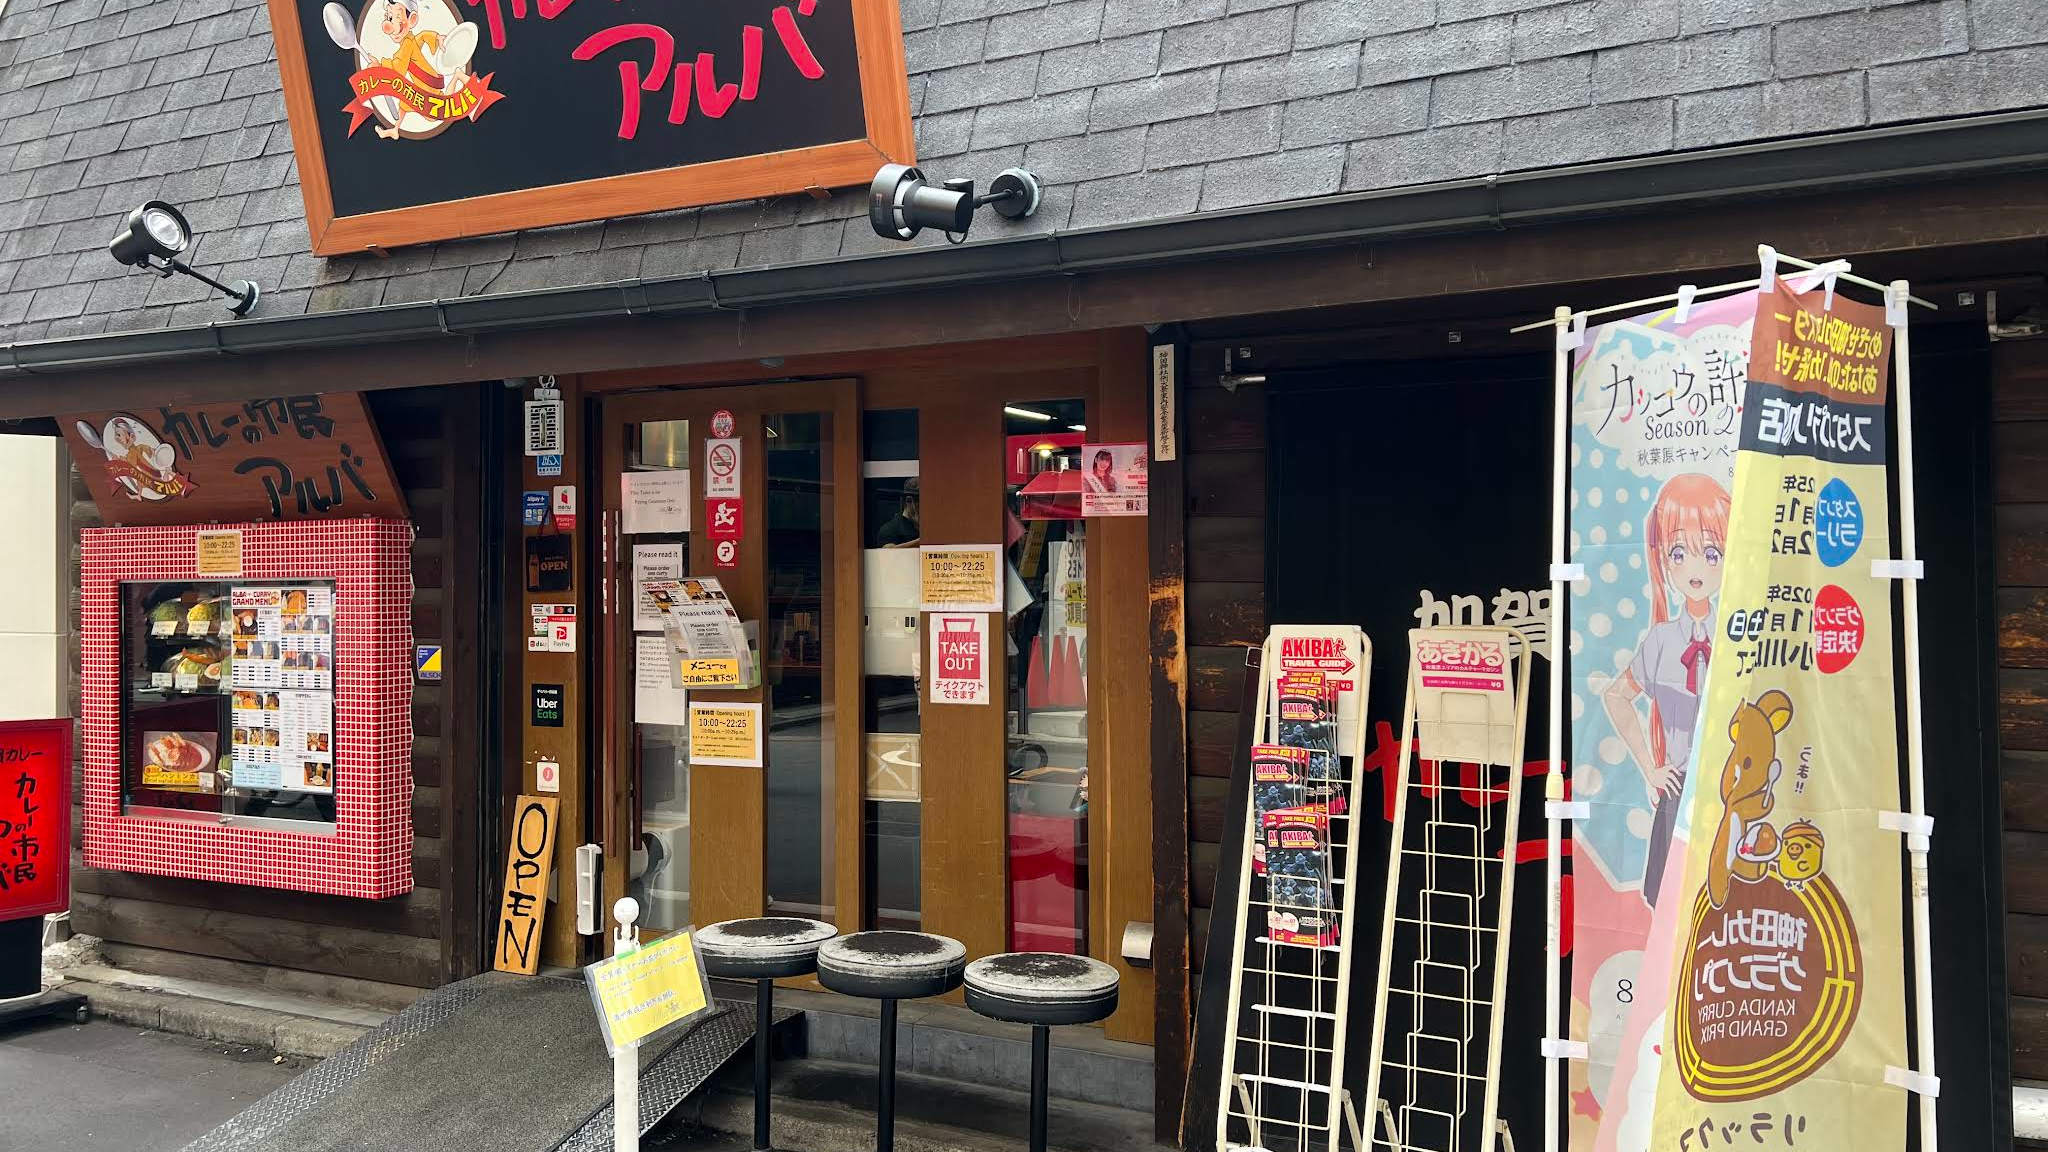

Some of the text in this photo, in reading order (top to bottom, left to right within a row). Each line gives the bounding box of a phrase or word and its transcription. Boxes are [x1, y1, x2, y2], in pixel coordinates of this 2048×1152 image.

[572, 0, 824, 139] アルバ
[358, 75, 478, 119] カレーの市民 アルバ
[1596, 349, 1749, 436] カッコウの許
[1644, 403, 1735, 441] Season 2
[234, 443, 378, 519] アルバ
[540, 560, 568, 572] OPEN
[232, 598, 254, 606] GRAND
[940, 641, 979, 655] TAKE
[1281, 638, 1334, 658] AKIBA
[1417, 639, 1504, 667] あきかる
[944, 657, 975, 671] OUT
[1284, 659, 1347, 668] TRAVEL GUIDE
[935, 680, 984, 692] テイクアウト
[943, 690, 977, 699] できます
[536, 698, 558, 709] Uber
[1283, 702, 1308, 712] AKIBA
[536, 709, 558, 719] Eats
[1256, 764, 1282, 774] AKIBA
[11, 771, 40, 884] カレーの市民
[1282, 831, 1309, 841] AKIBA
[503, 802, 548, 969] OPEN
[1616, 978, 1634, 1004] 8
